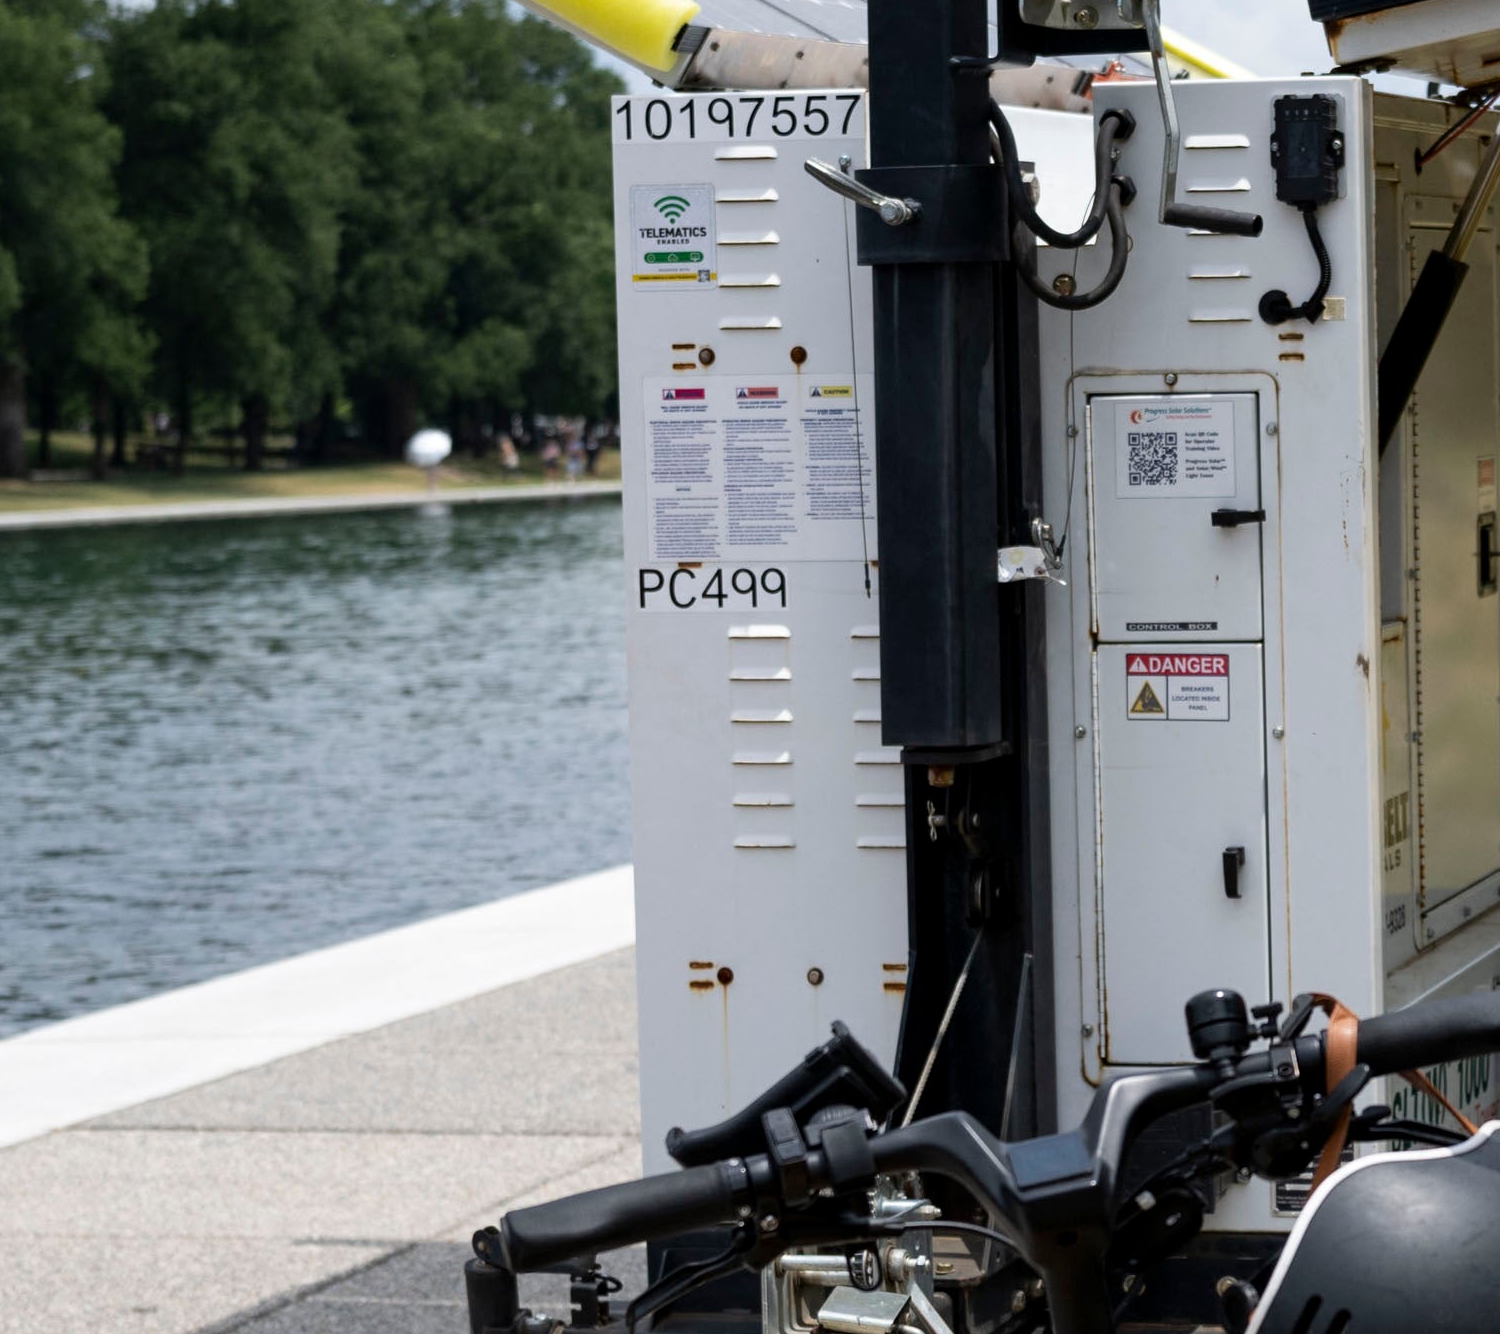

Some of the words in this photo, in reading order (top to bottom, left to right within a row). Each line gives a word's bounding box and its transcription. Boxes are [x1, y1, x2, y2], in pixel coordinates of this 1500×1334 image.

[616, 95, 861, 140] 10197557
[639, 227, 707, 238] TELEMATICS
[639, 568, 787, 609] PC499
[1128, 623, 1184, 631] CONTROL
[1149, 657, 1225, 673] DANGER
